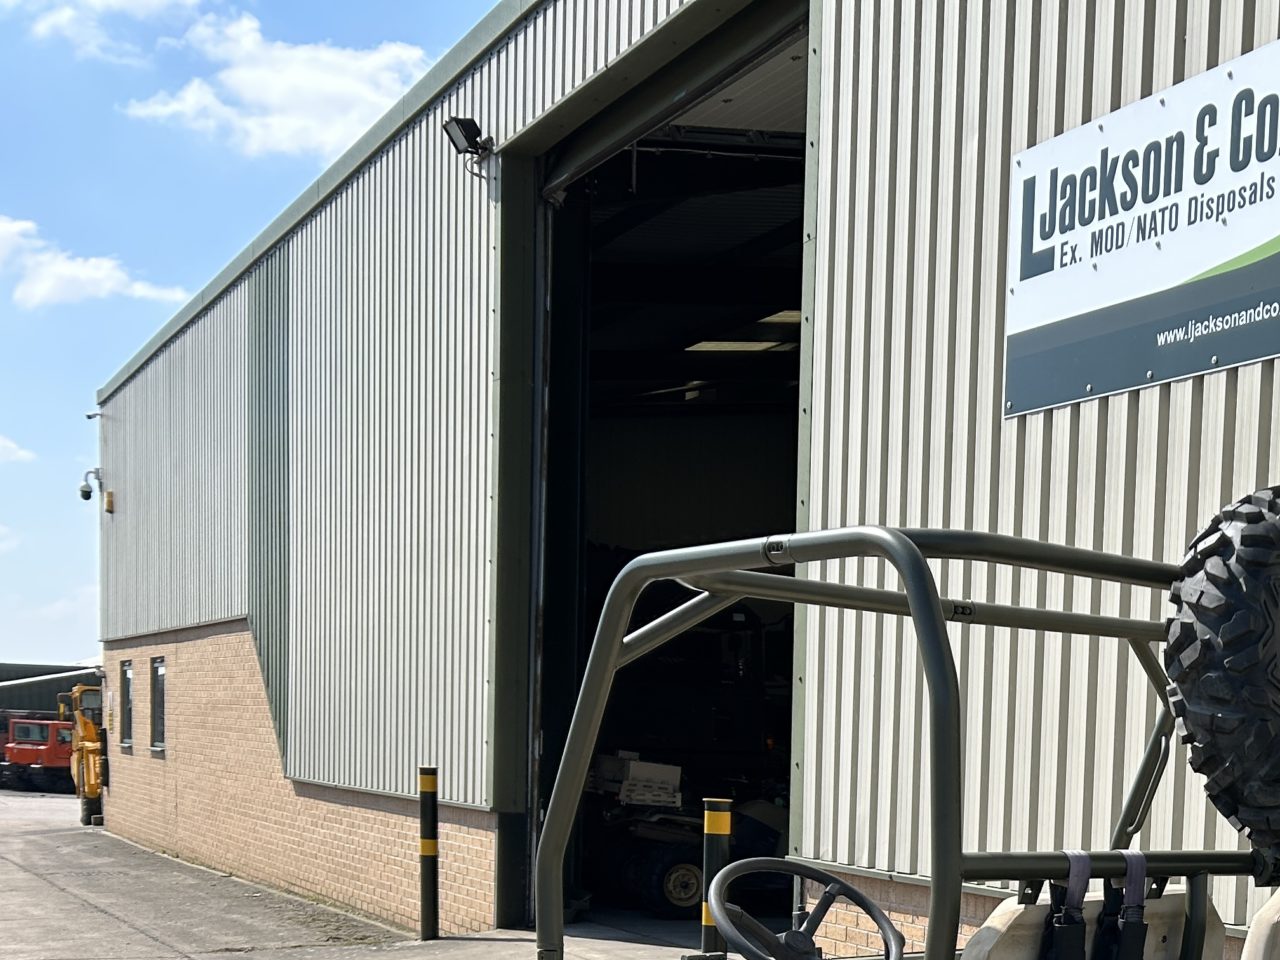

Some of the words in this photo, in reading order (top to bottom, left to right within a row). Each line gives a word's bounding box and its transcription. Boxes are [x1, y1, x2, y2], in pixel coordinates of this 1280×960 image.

[1193, 103, 1220, 186] &
[1059, 241, 1083, 269] Ex.
[1090, 202, 1179, 258] MOD/NATO
[1187, 171, 1276, 226] Disposals
